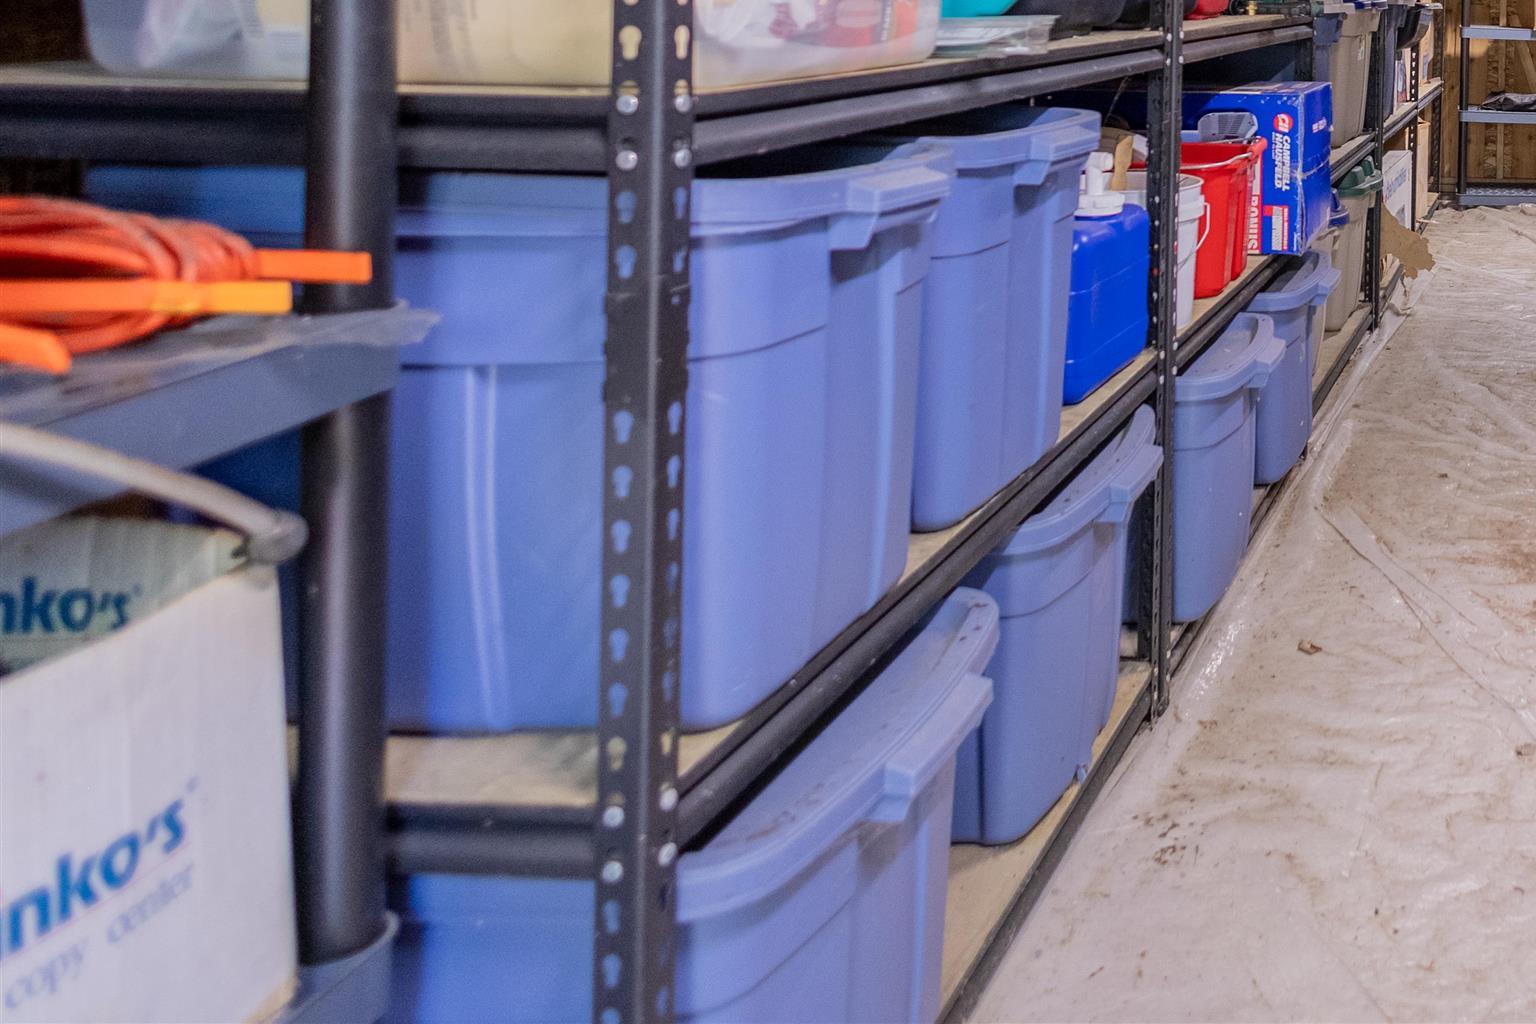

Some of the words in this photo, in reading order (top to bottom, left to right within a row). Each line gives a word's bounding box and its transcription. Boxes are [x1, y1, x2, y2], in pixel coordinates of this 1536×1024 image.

[1274, 133, 1283, 189] HAUSFELD
[1282, 135, 1291, 192] CAMPBELL
[4, 937, 90, 1010] copy
[106, 861, 195, 943] center
